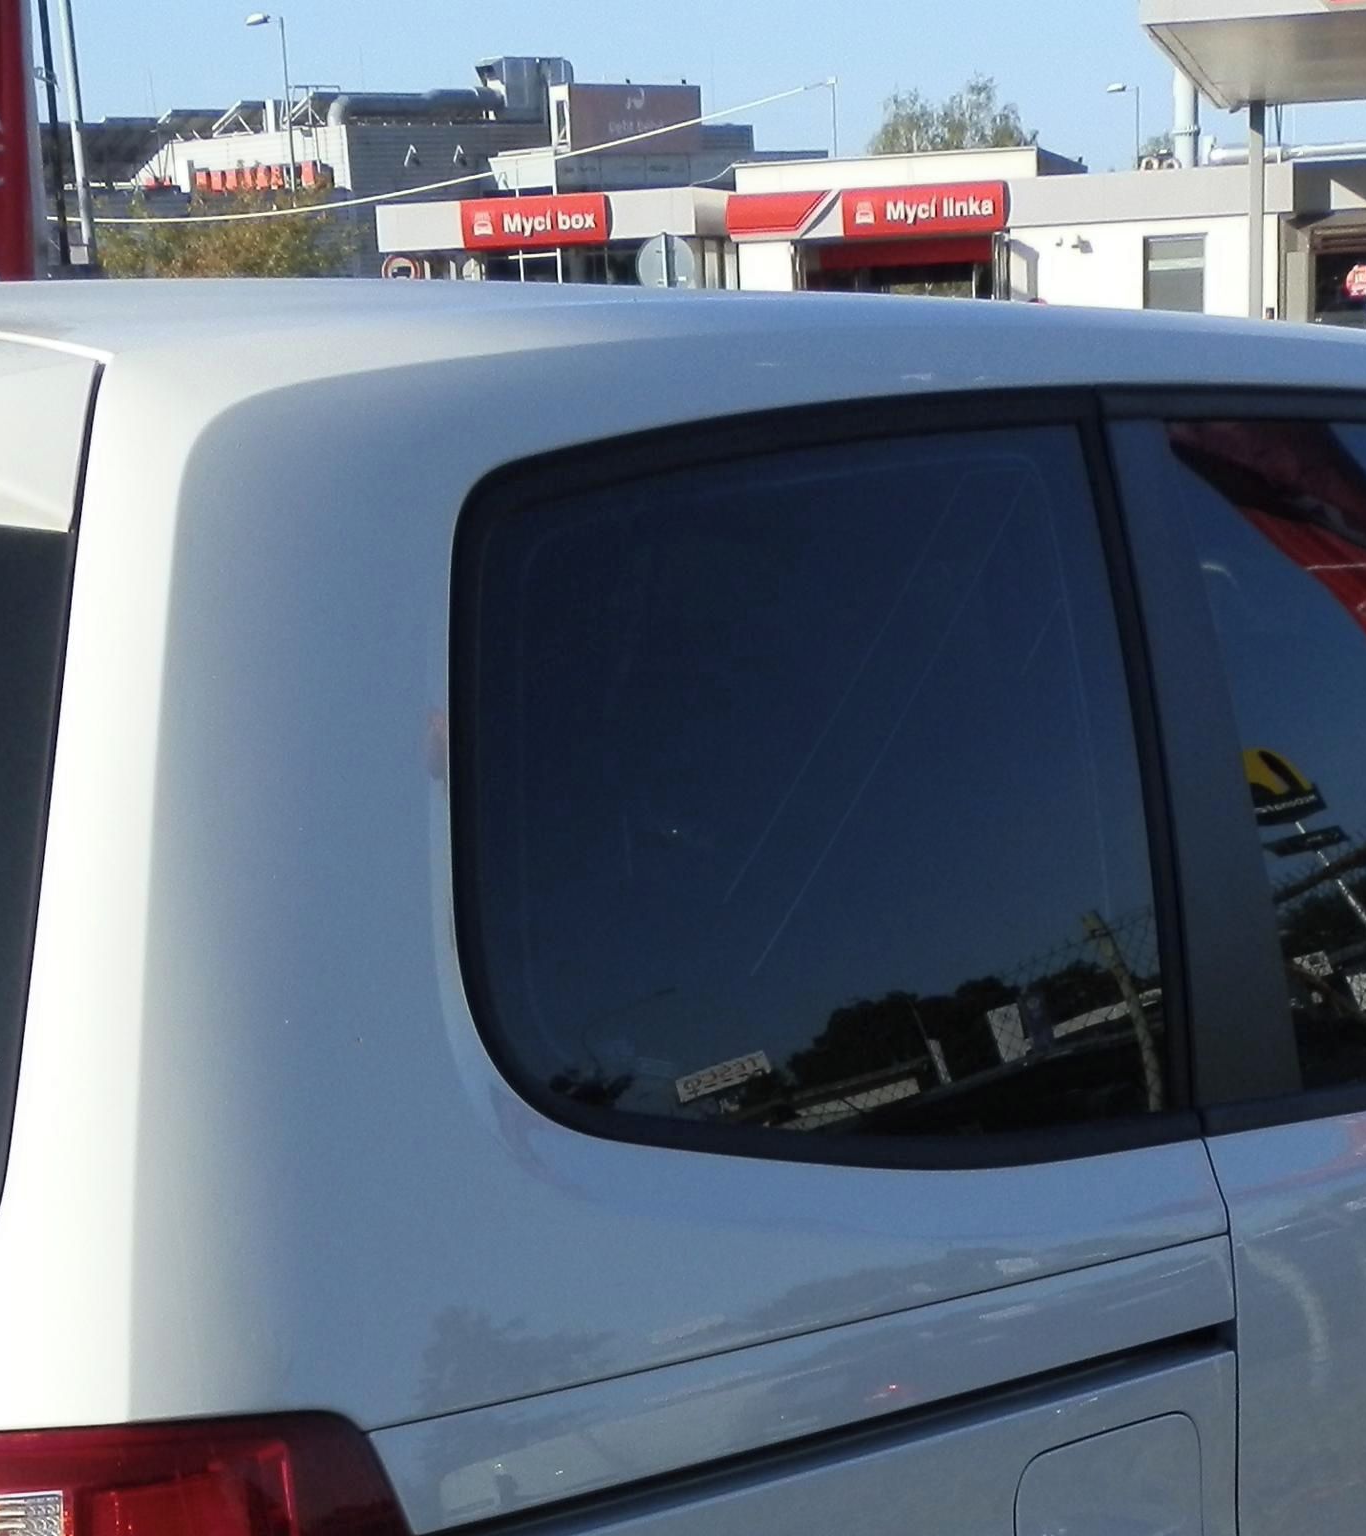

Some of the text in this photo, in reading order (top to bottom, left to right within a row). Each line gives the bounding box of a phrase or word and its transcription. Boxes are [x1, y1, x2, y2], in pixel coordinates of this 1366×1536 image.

[503, 208, 596, 237] Mycí box
[886, 195, 995, 225] Mycí linka
